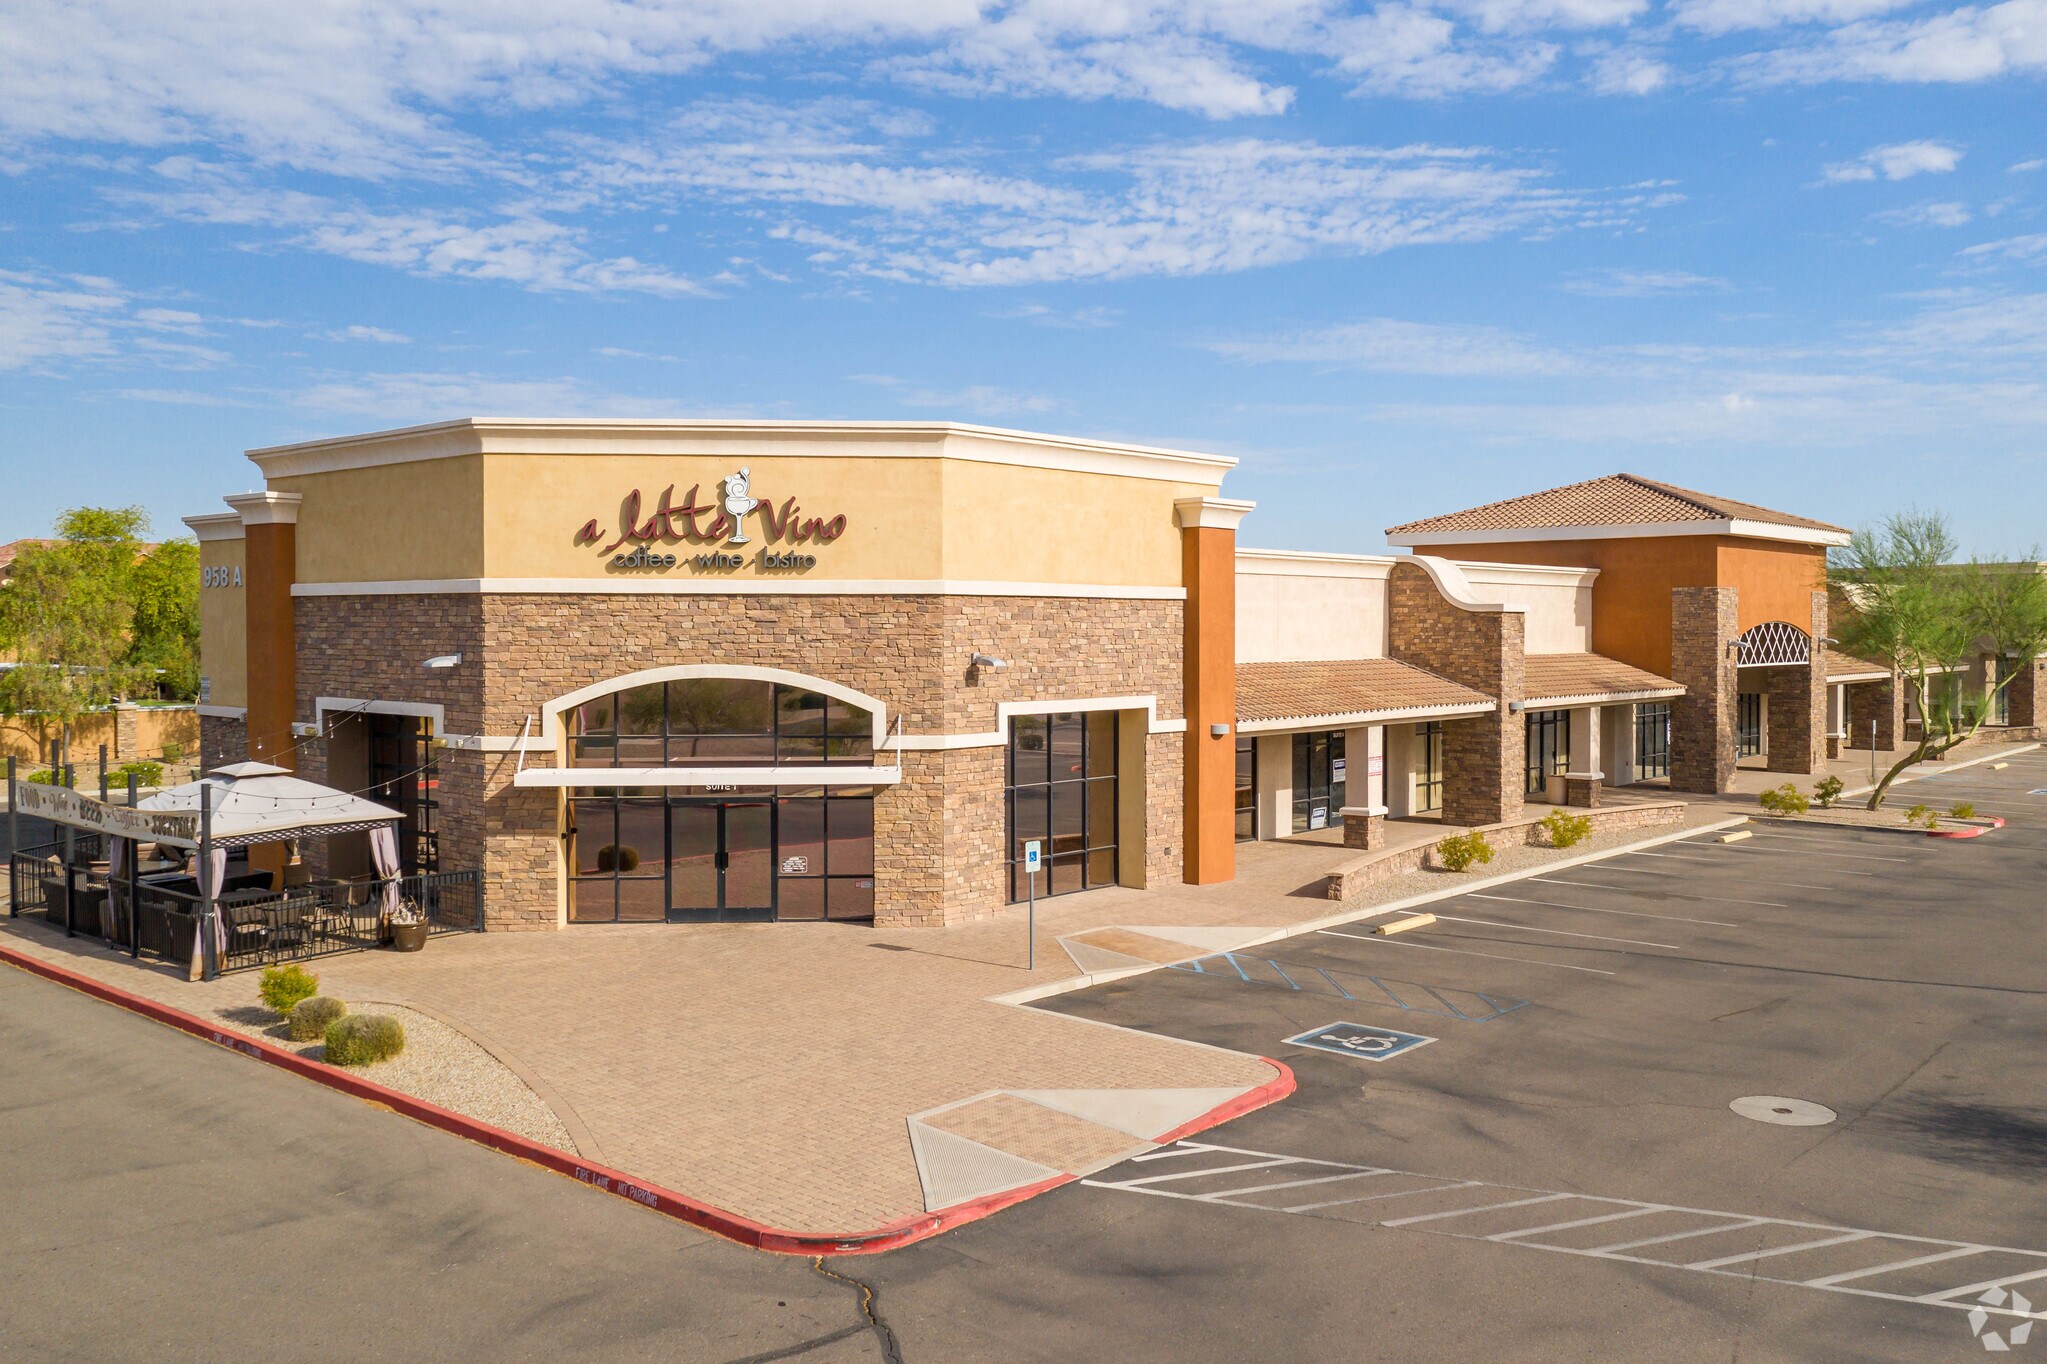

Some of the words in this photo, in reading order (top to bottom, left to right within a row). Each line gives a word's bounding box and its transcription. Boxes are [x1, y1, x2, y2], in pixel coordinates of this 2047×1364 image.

[579, 518, 606, 541] a
[605, 483, 731, 550] latte
[754, 495, 847, 540] Vino
[204, 566, 229, 587] 958
[233, 566, 243, 587] A
[613, 545, 677, 568] coffee
[696, 550, 743, 568] wine
[763, 545, 816, 568] bistro
[19, 786, 40, 809] FOOD
[49, 793, 68, 813] Wine
[111, 809, 140, 831] Coffee
[575, 1166, 591, 1182] FIRE
[592, 1172, 610, 1190] LANE
[617, 1181, 628, 1196] NO
[629, 1185, 658, 1208] PARKING
